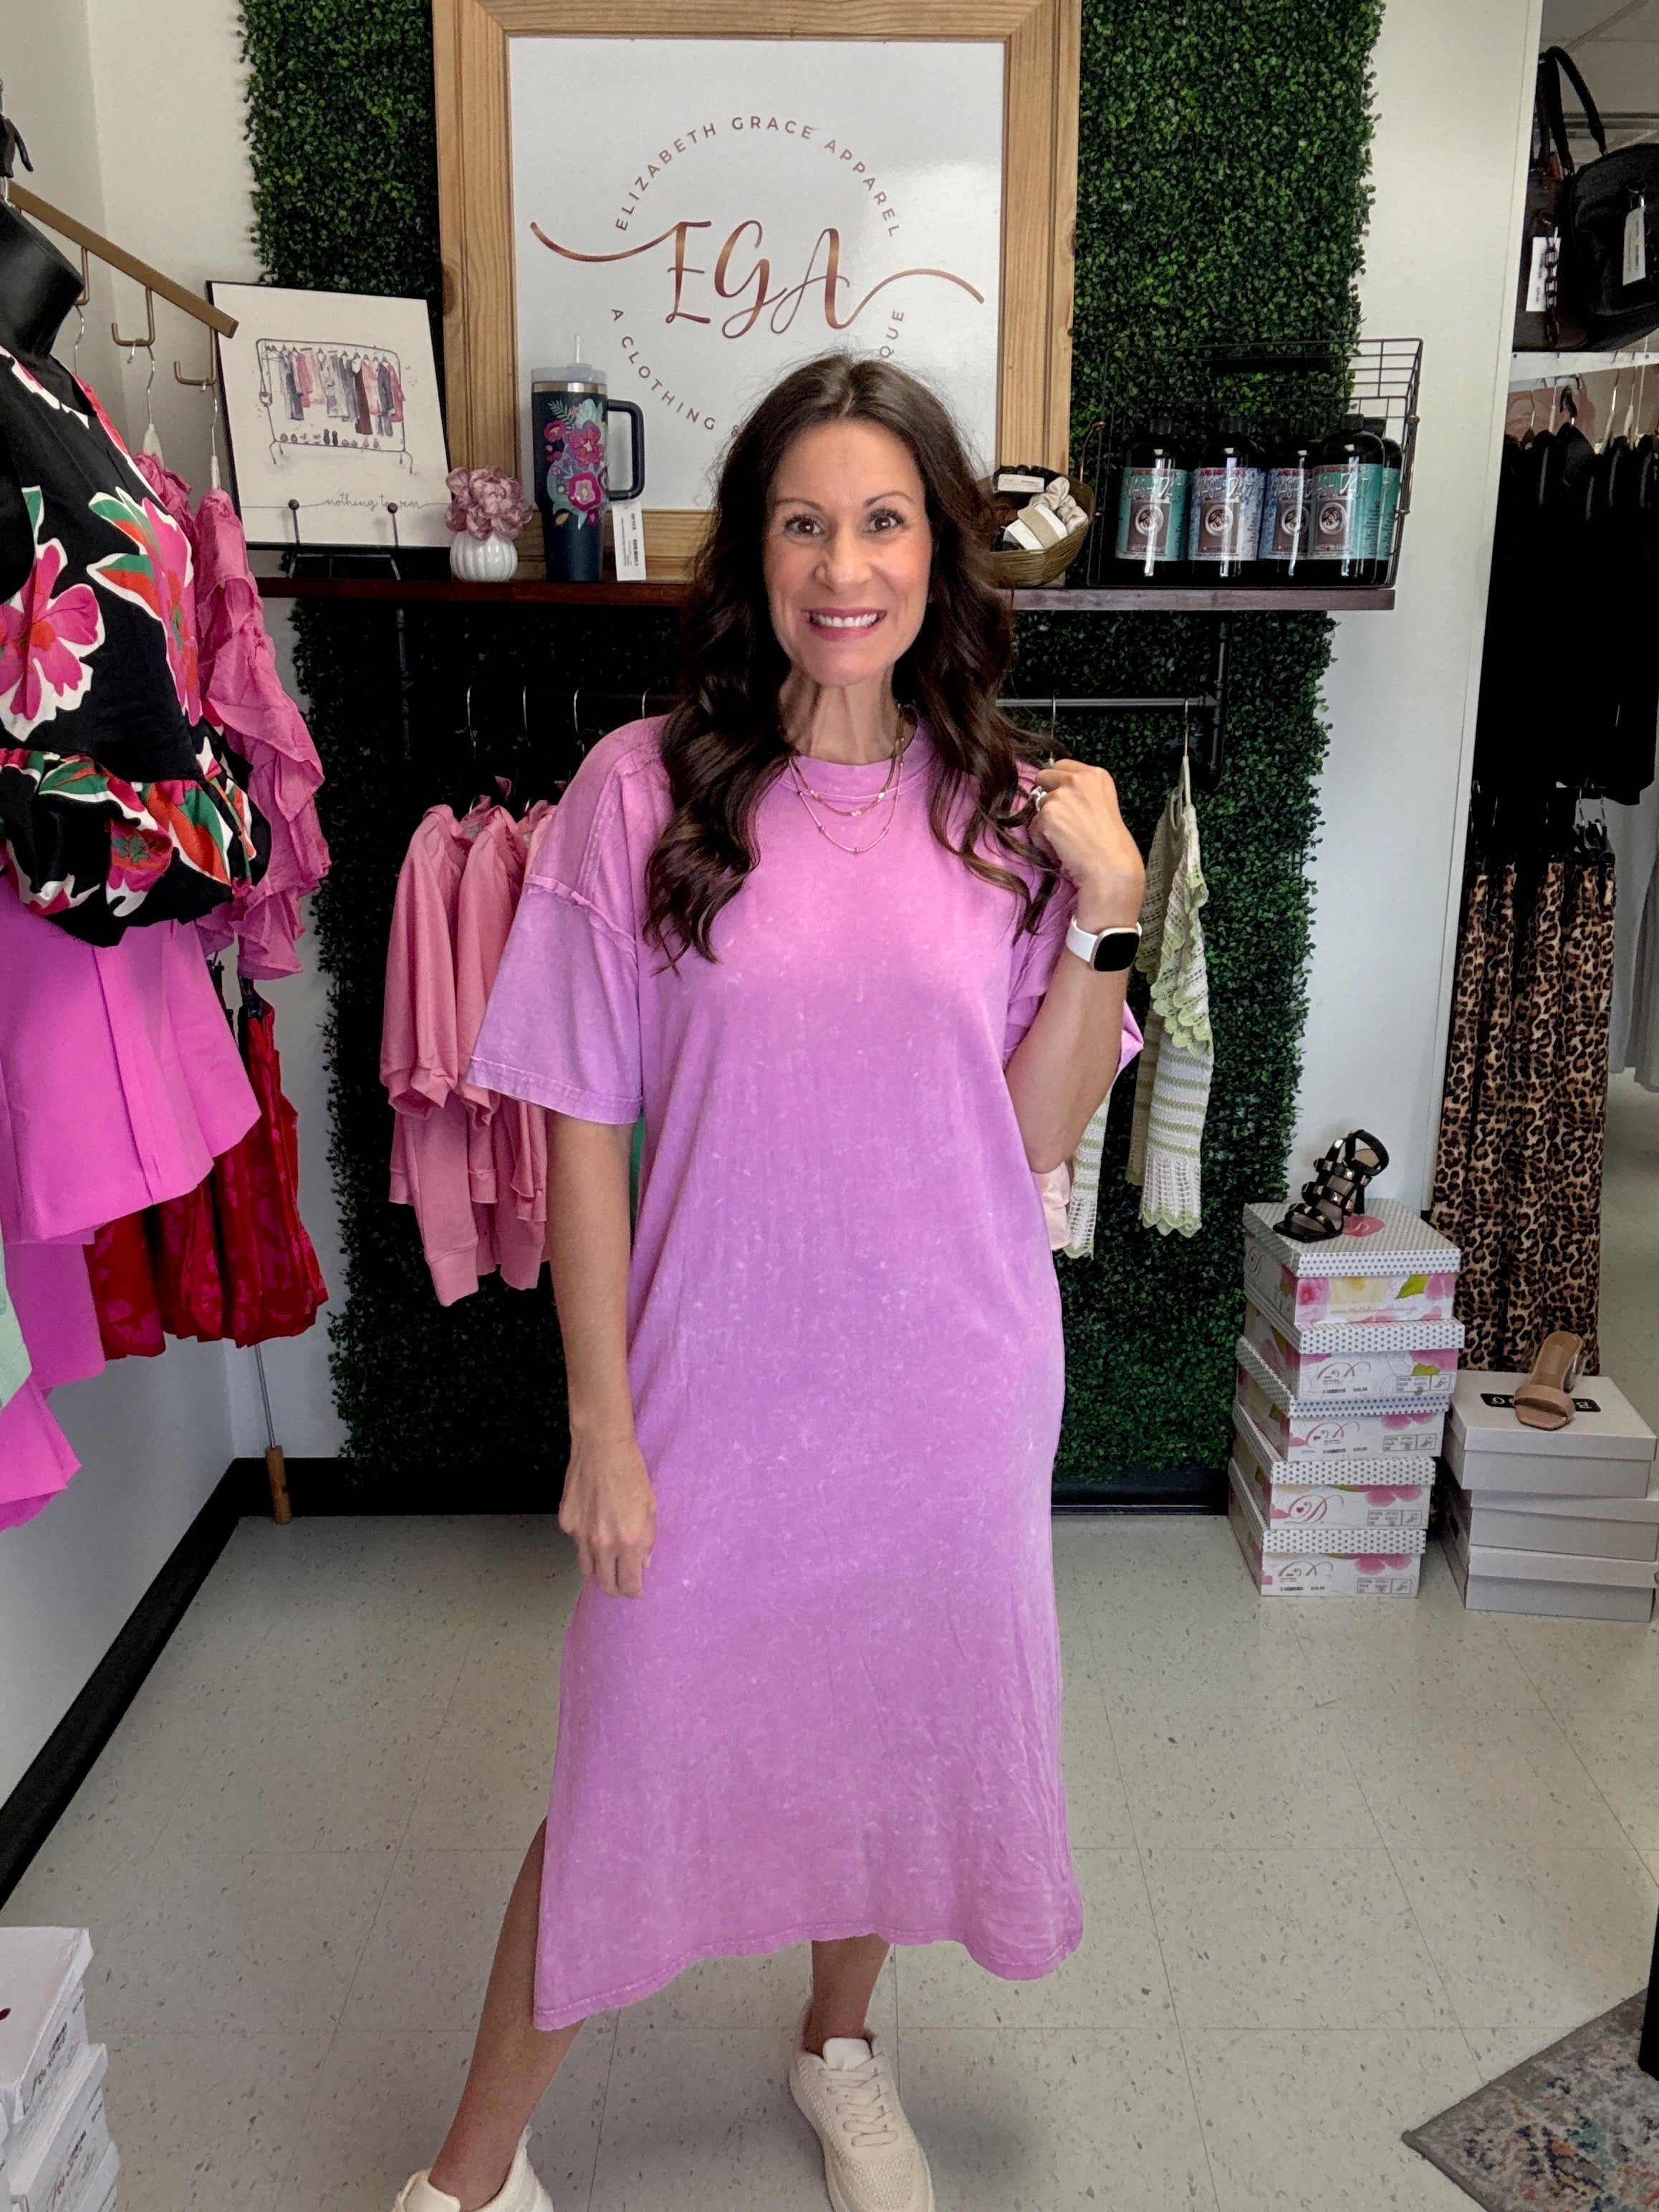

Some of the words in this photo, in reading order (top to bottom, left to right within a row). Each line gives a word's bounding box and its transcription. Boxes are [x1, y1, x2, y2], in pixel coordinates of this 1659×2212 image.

[615, 123, 716, 231] ELIZABETH
[731, 115, 813, 139] GRACE
[824, 139, 900, 237] APPAREL
[612, 309, 624, 321] A
[622, 336, 716, 430] CLOTHING
[324, 491, 378, 511] nothing
